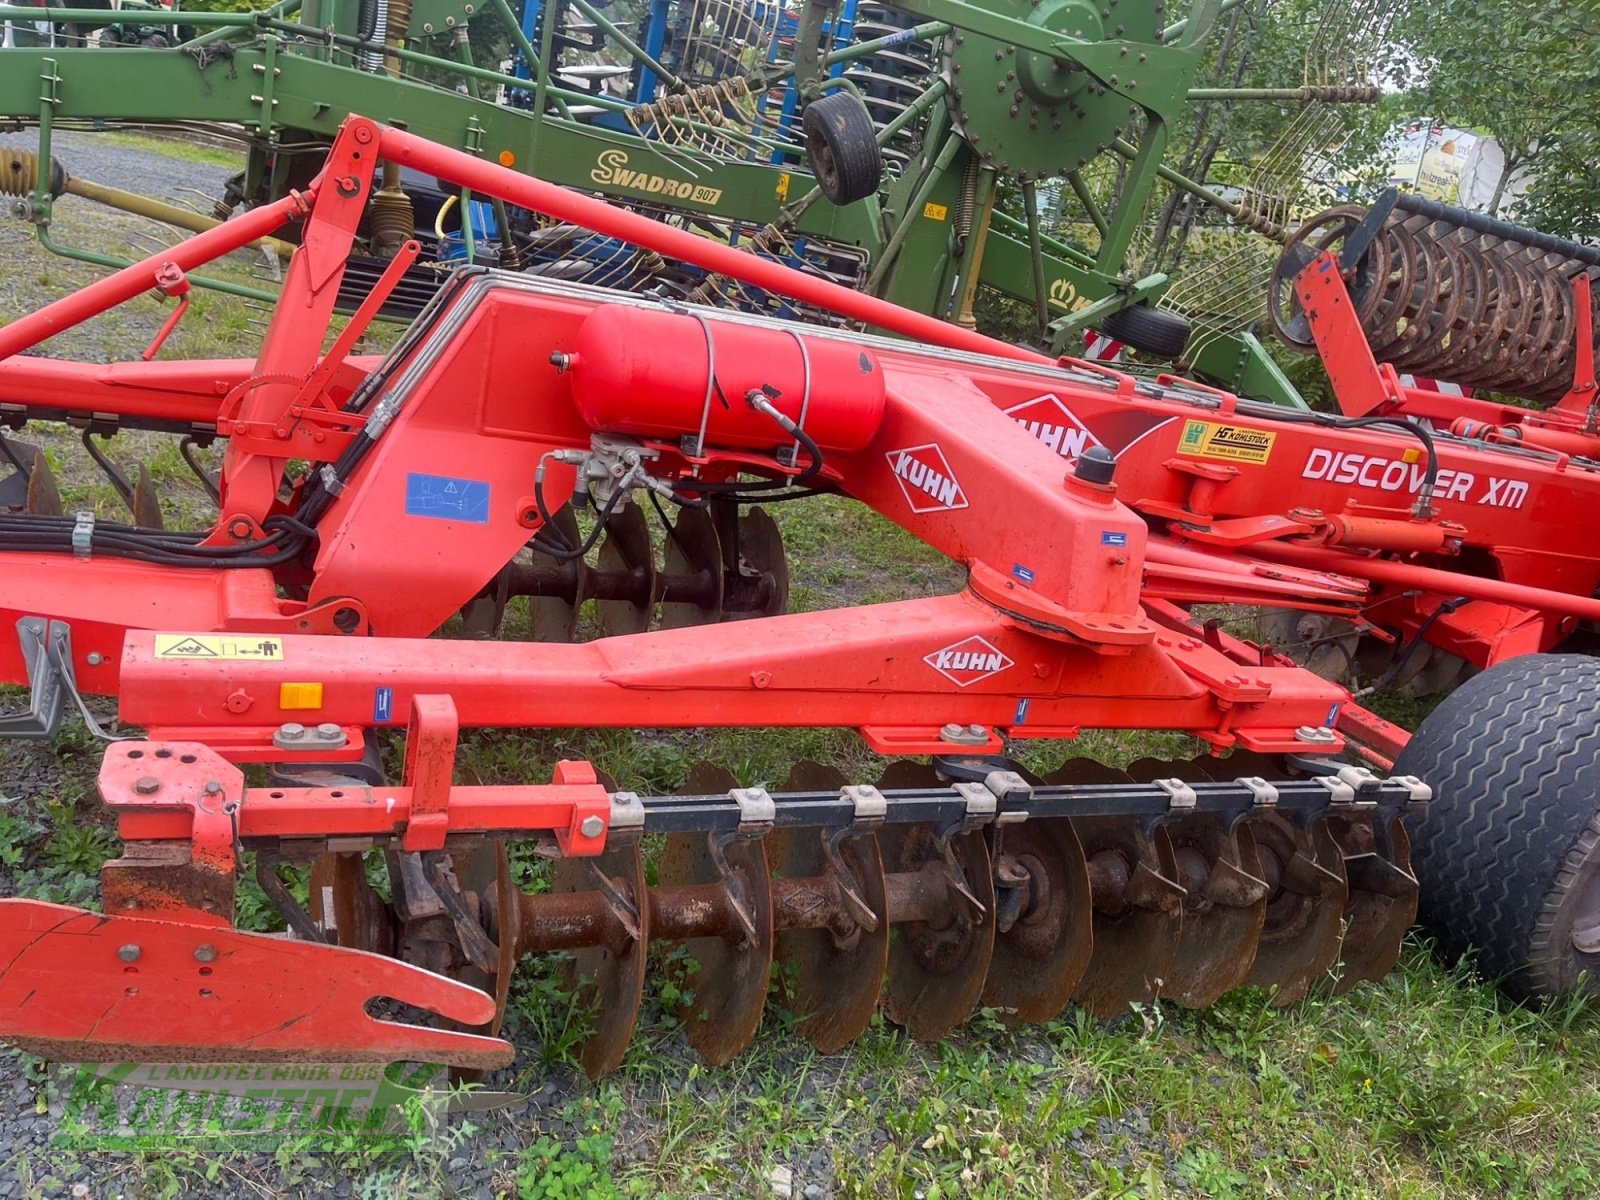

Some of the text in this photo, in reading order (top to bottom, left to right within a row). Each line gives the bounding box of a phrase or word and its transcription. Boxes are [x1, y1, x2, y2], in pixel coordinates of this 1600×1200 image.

[591, 149, 717, 201] SWADRO 907
[895, 450, 958, 508] KUHN
[1302, 448, 1529, 509] DISCOVER XM
[936, 649, 1003, 671] KUHN
